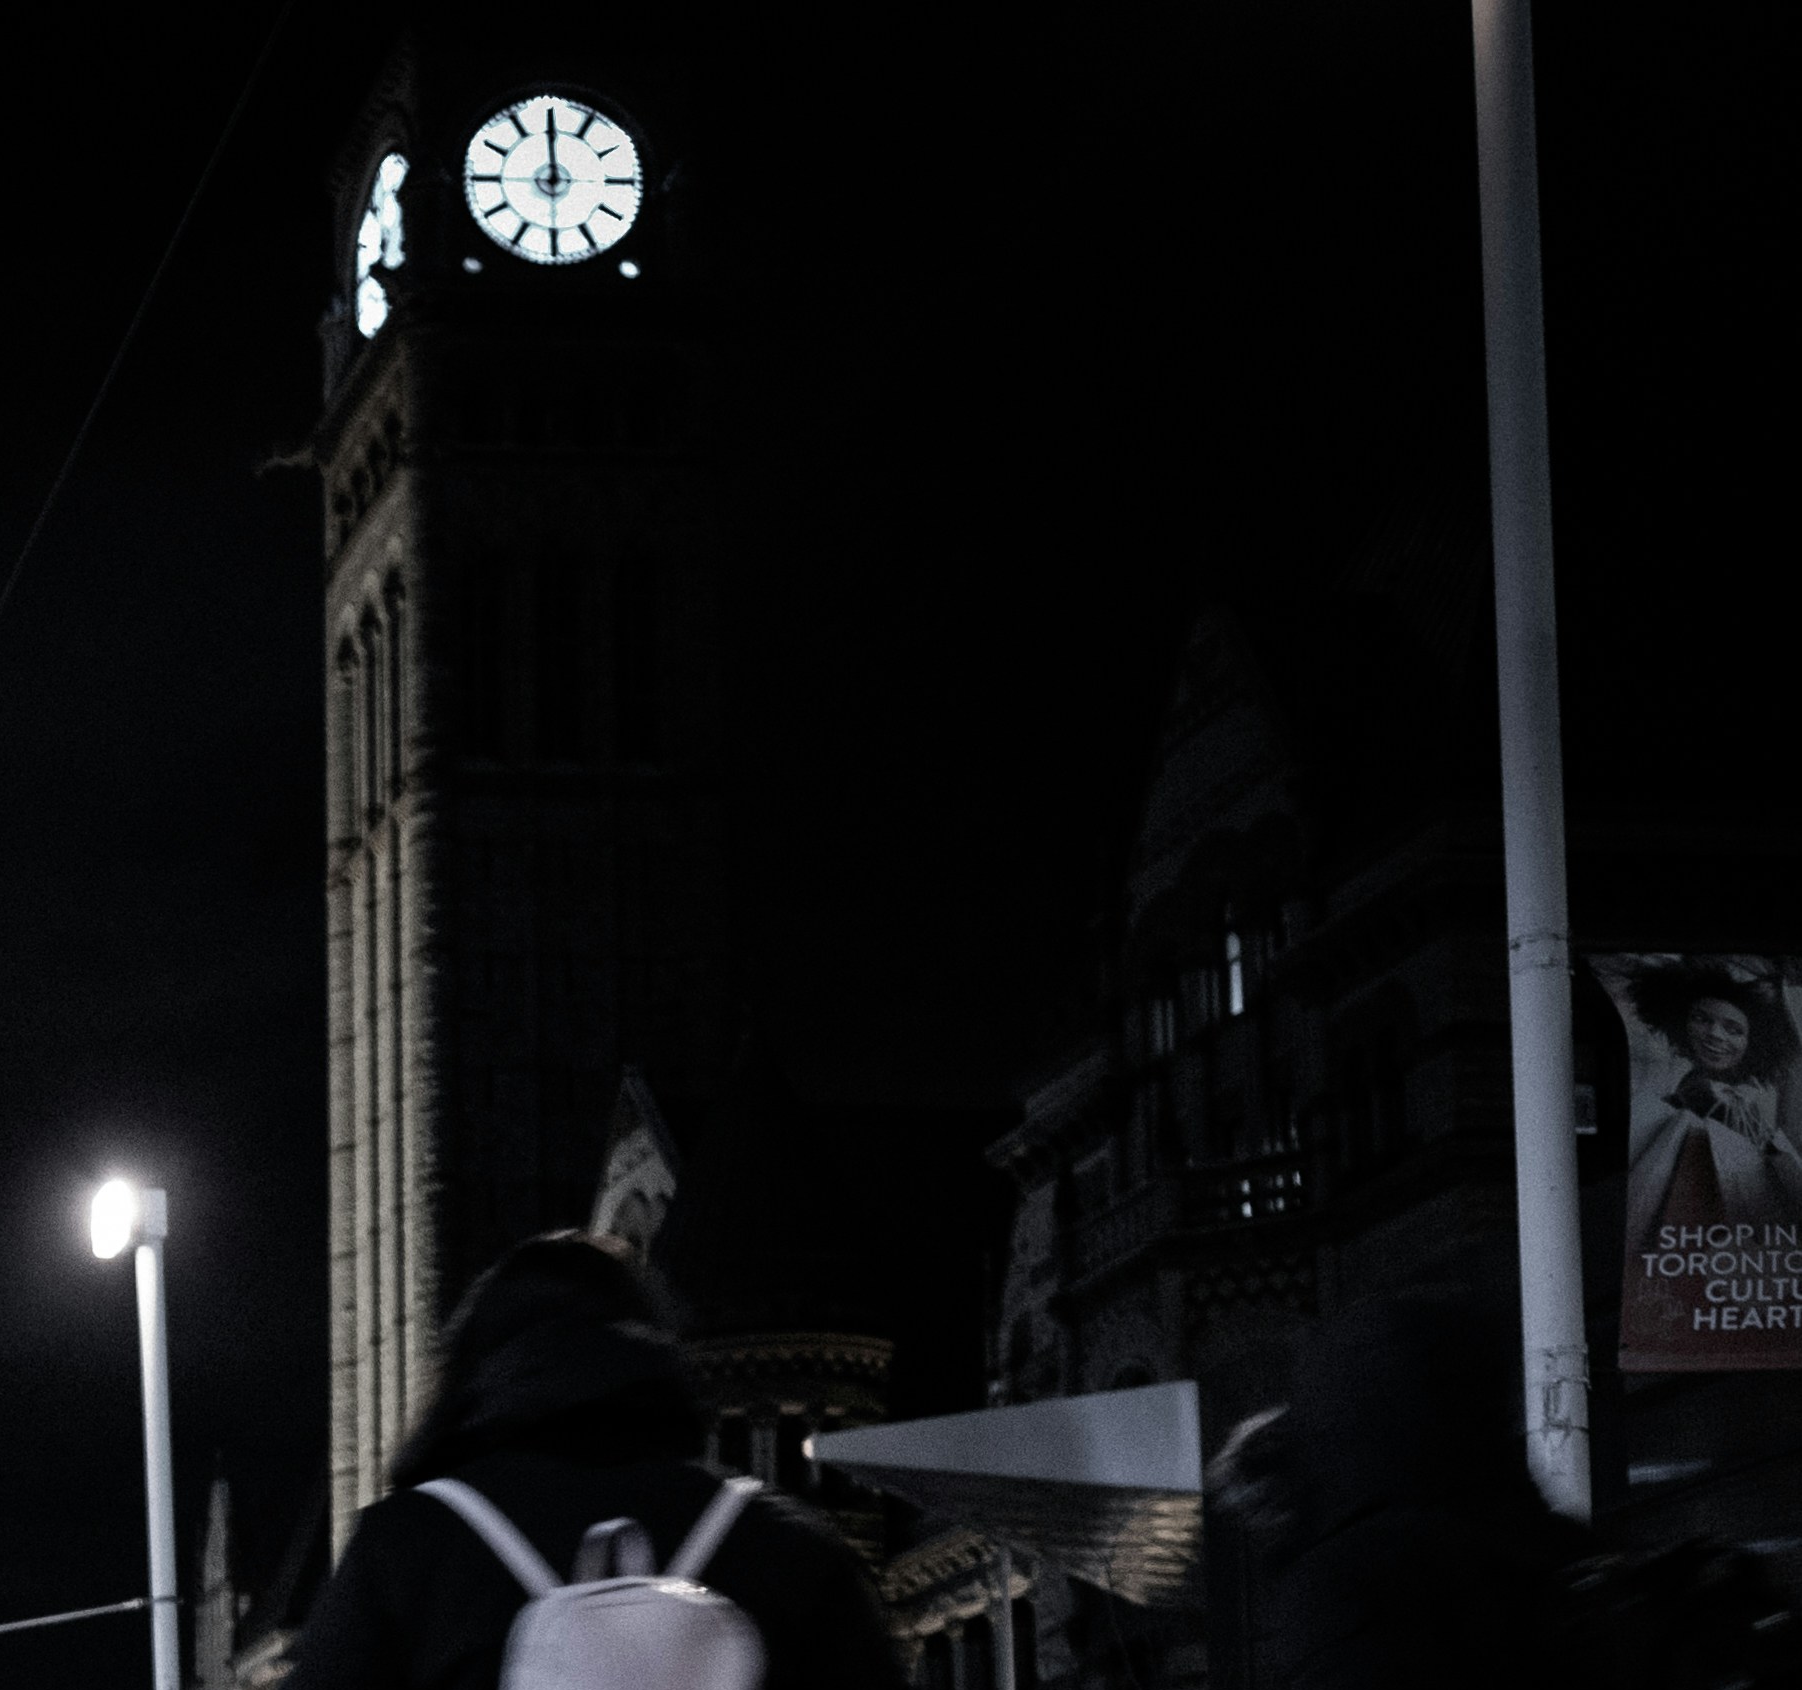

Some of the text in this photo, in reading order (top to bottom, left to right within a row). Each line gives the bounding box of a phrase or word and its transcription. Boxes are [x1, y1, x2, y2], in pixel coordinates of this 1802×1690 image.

[1659, 1223, 1796, 1250] SHOP IN
[1642, 1250, 1802, 1279] TORONTO
[1693, 1305, 1802, 1331] HEART
